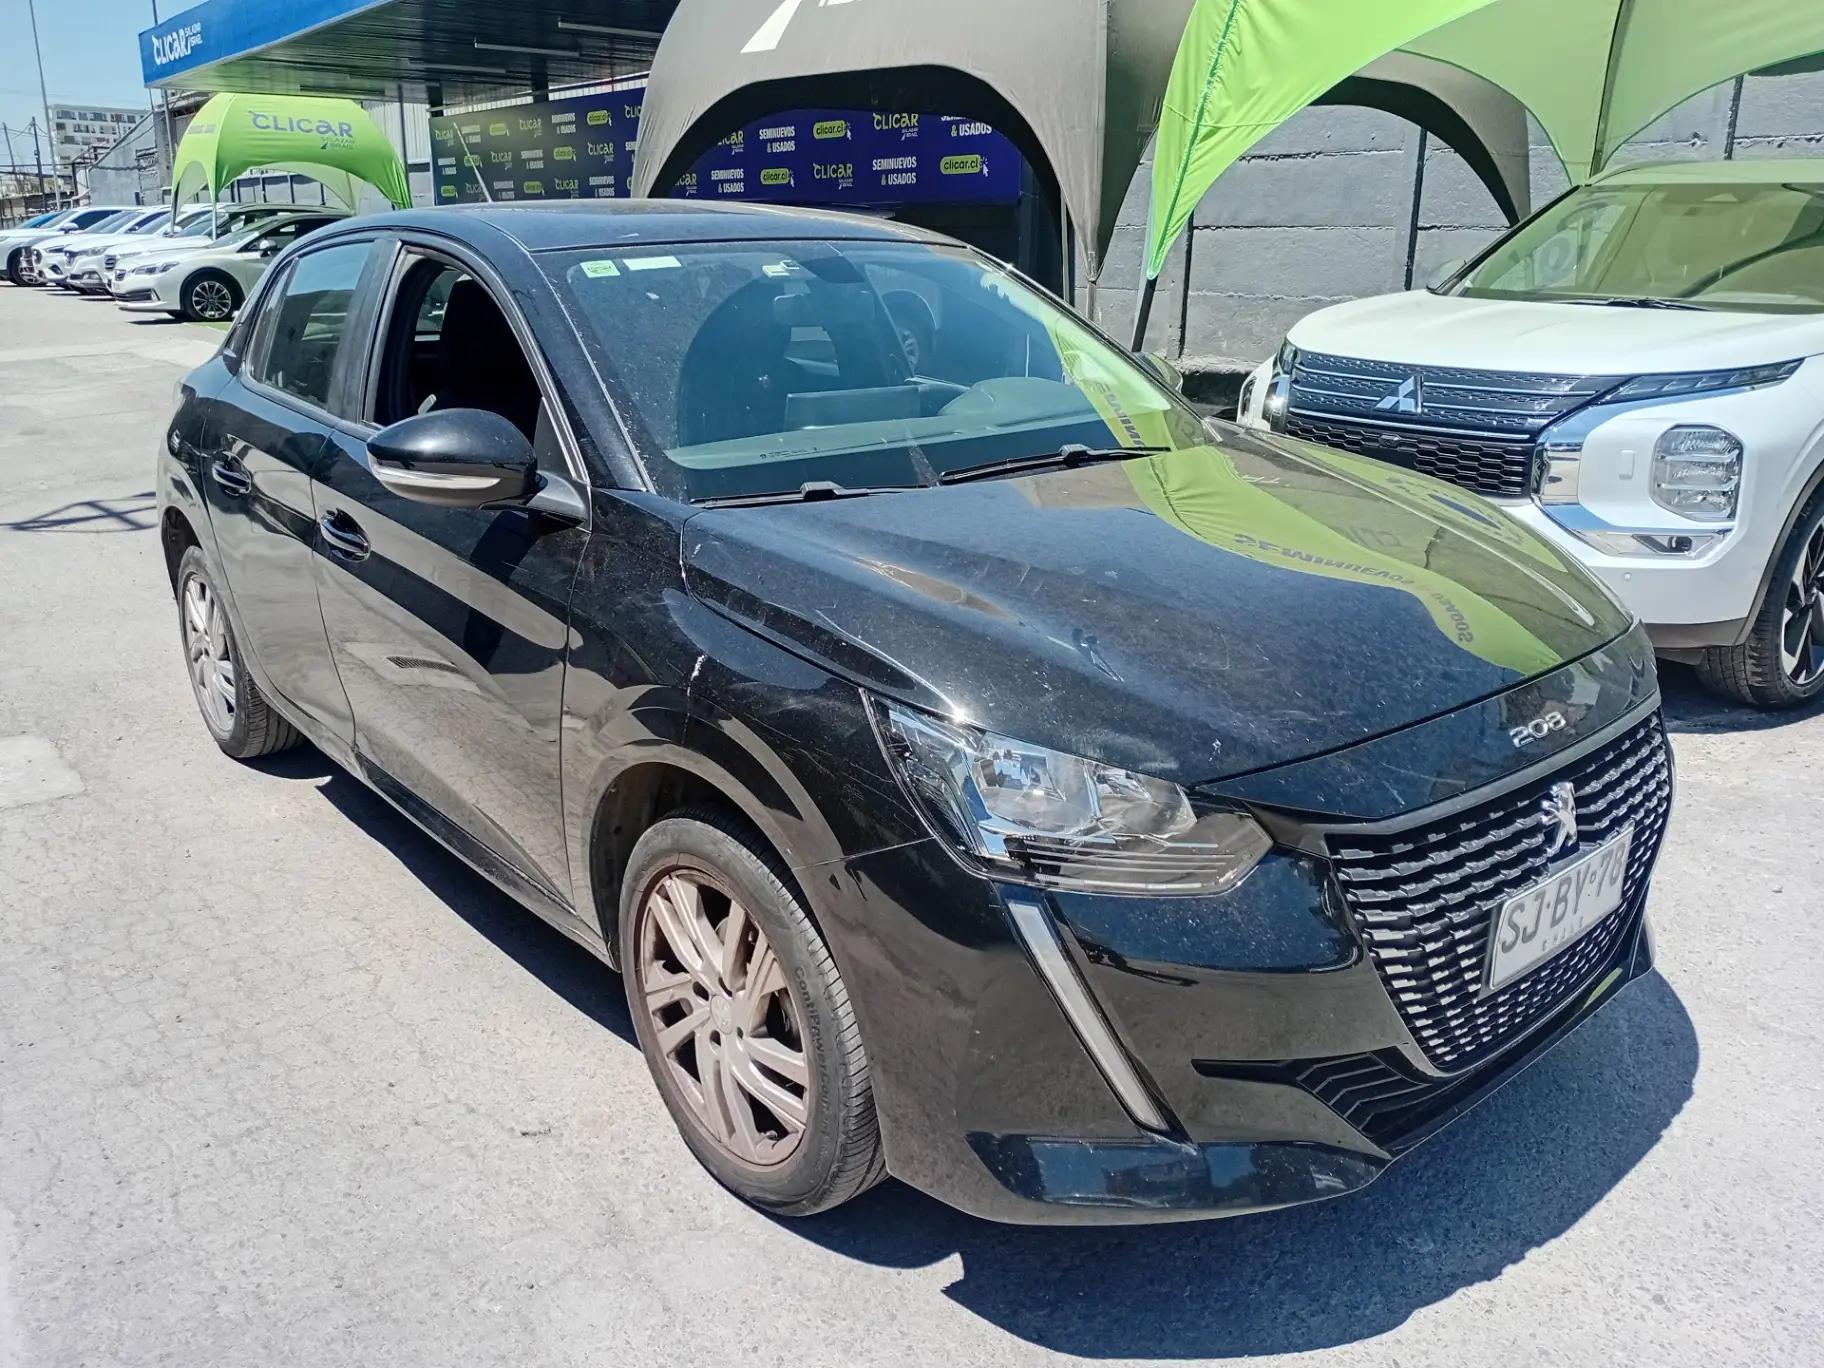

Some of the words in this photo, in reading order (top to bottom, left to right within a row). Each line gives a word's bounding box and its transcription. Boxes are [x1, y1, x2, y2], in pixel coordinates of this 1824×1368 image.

[872, 156, 917, 171] SEMINUEVOS
[943, 157, 978, 171] clicar.cl
[888, 172, 917, 185] USADOS
[1509, 711, 1567, 748] 208
